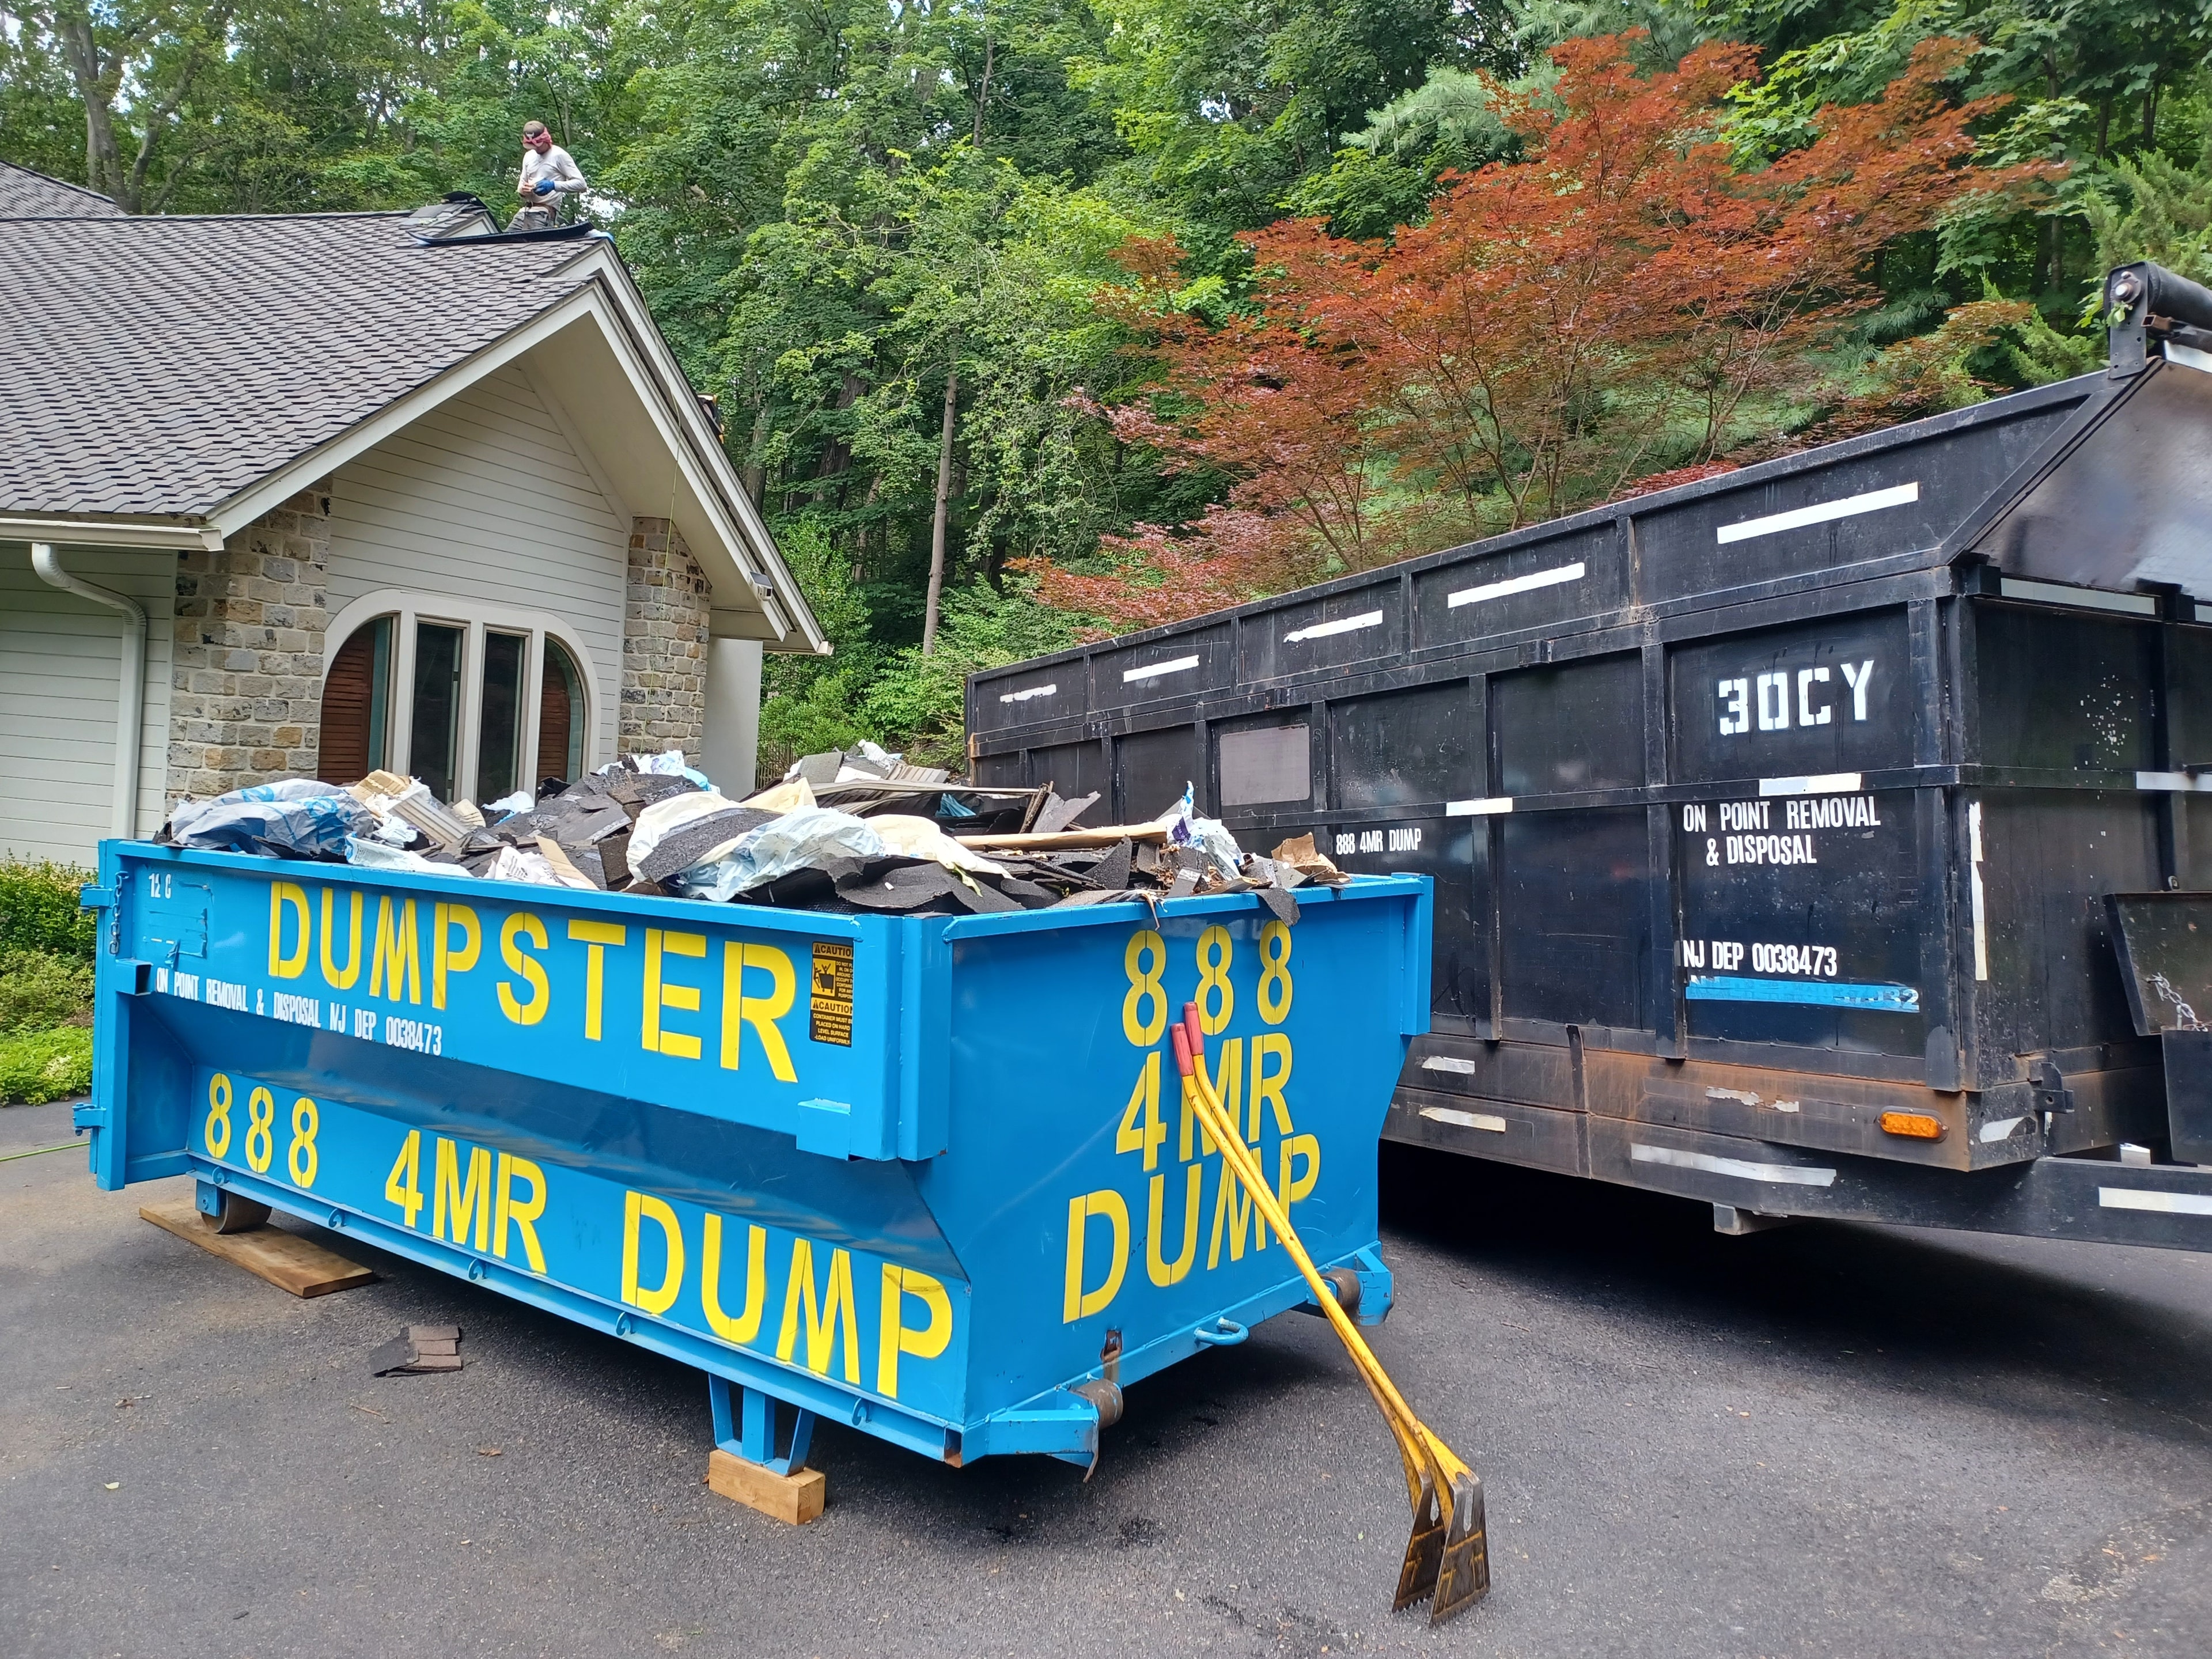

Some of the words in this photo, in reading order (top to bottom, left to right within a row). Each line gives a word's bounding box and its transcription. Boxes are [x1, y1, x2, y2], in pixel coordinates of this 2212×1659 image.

[1718, 660, 1875, 736] 30CY
[1336, 833, 1355, 855] 888
[1359, 830, 1383, 853] 4MR
[1389, 828, 1422, 851] DUMP
[1683, 804, 1706, 832] ON
[1720, 801, 1770, 831] POINT
[1786, 796, 1881, 830] REMOVAL
[1706, 838, 1719, 866] &
[1726, 835, 1817, 865] DISPOSAL
[821, 945, 853, 958] CAUTIO
[1683, 940, 1705, 968] NJ
[1712, 941, 1744, 971] DEP
[1752, 943, 1838, 976] 0038473
[268, 881, 798, 1082] DUMPSTER
[156, 967, 169, 993] ON
[174, 971, 199, 1001] POINT
[206, 978, 248, 1012] REMOVAL
[256, 988, 264, 1016] &
[274, 991, 321, 1028] DISPOSAL
[329, 1002, 347, 1033] NJ
[354, 1009, 377, 1041] DEP
[386, 1016, 442, 1056] 0038473
[204, 1073, 319, 1188] 888
[385, 1129, 548, 1275] 4MR
[621, 1190, 952, 1399] DUMP
[1063, 1134, 1321, 1324] DUMP
